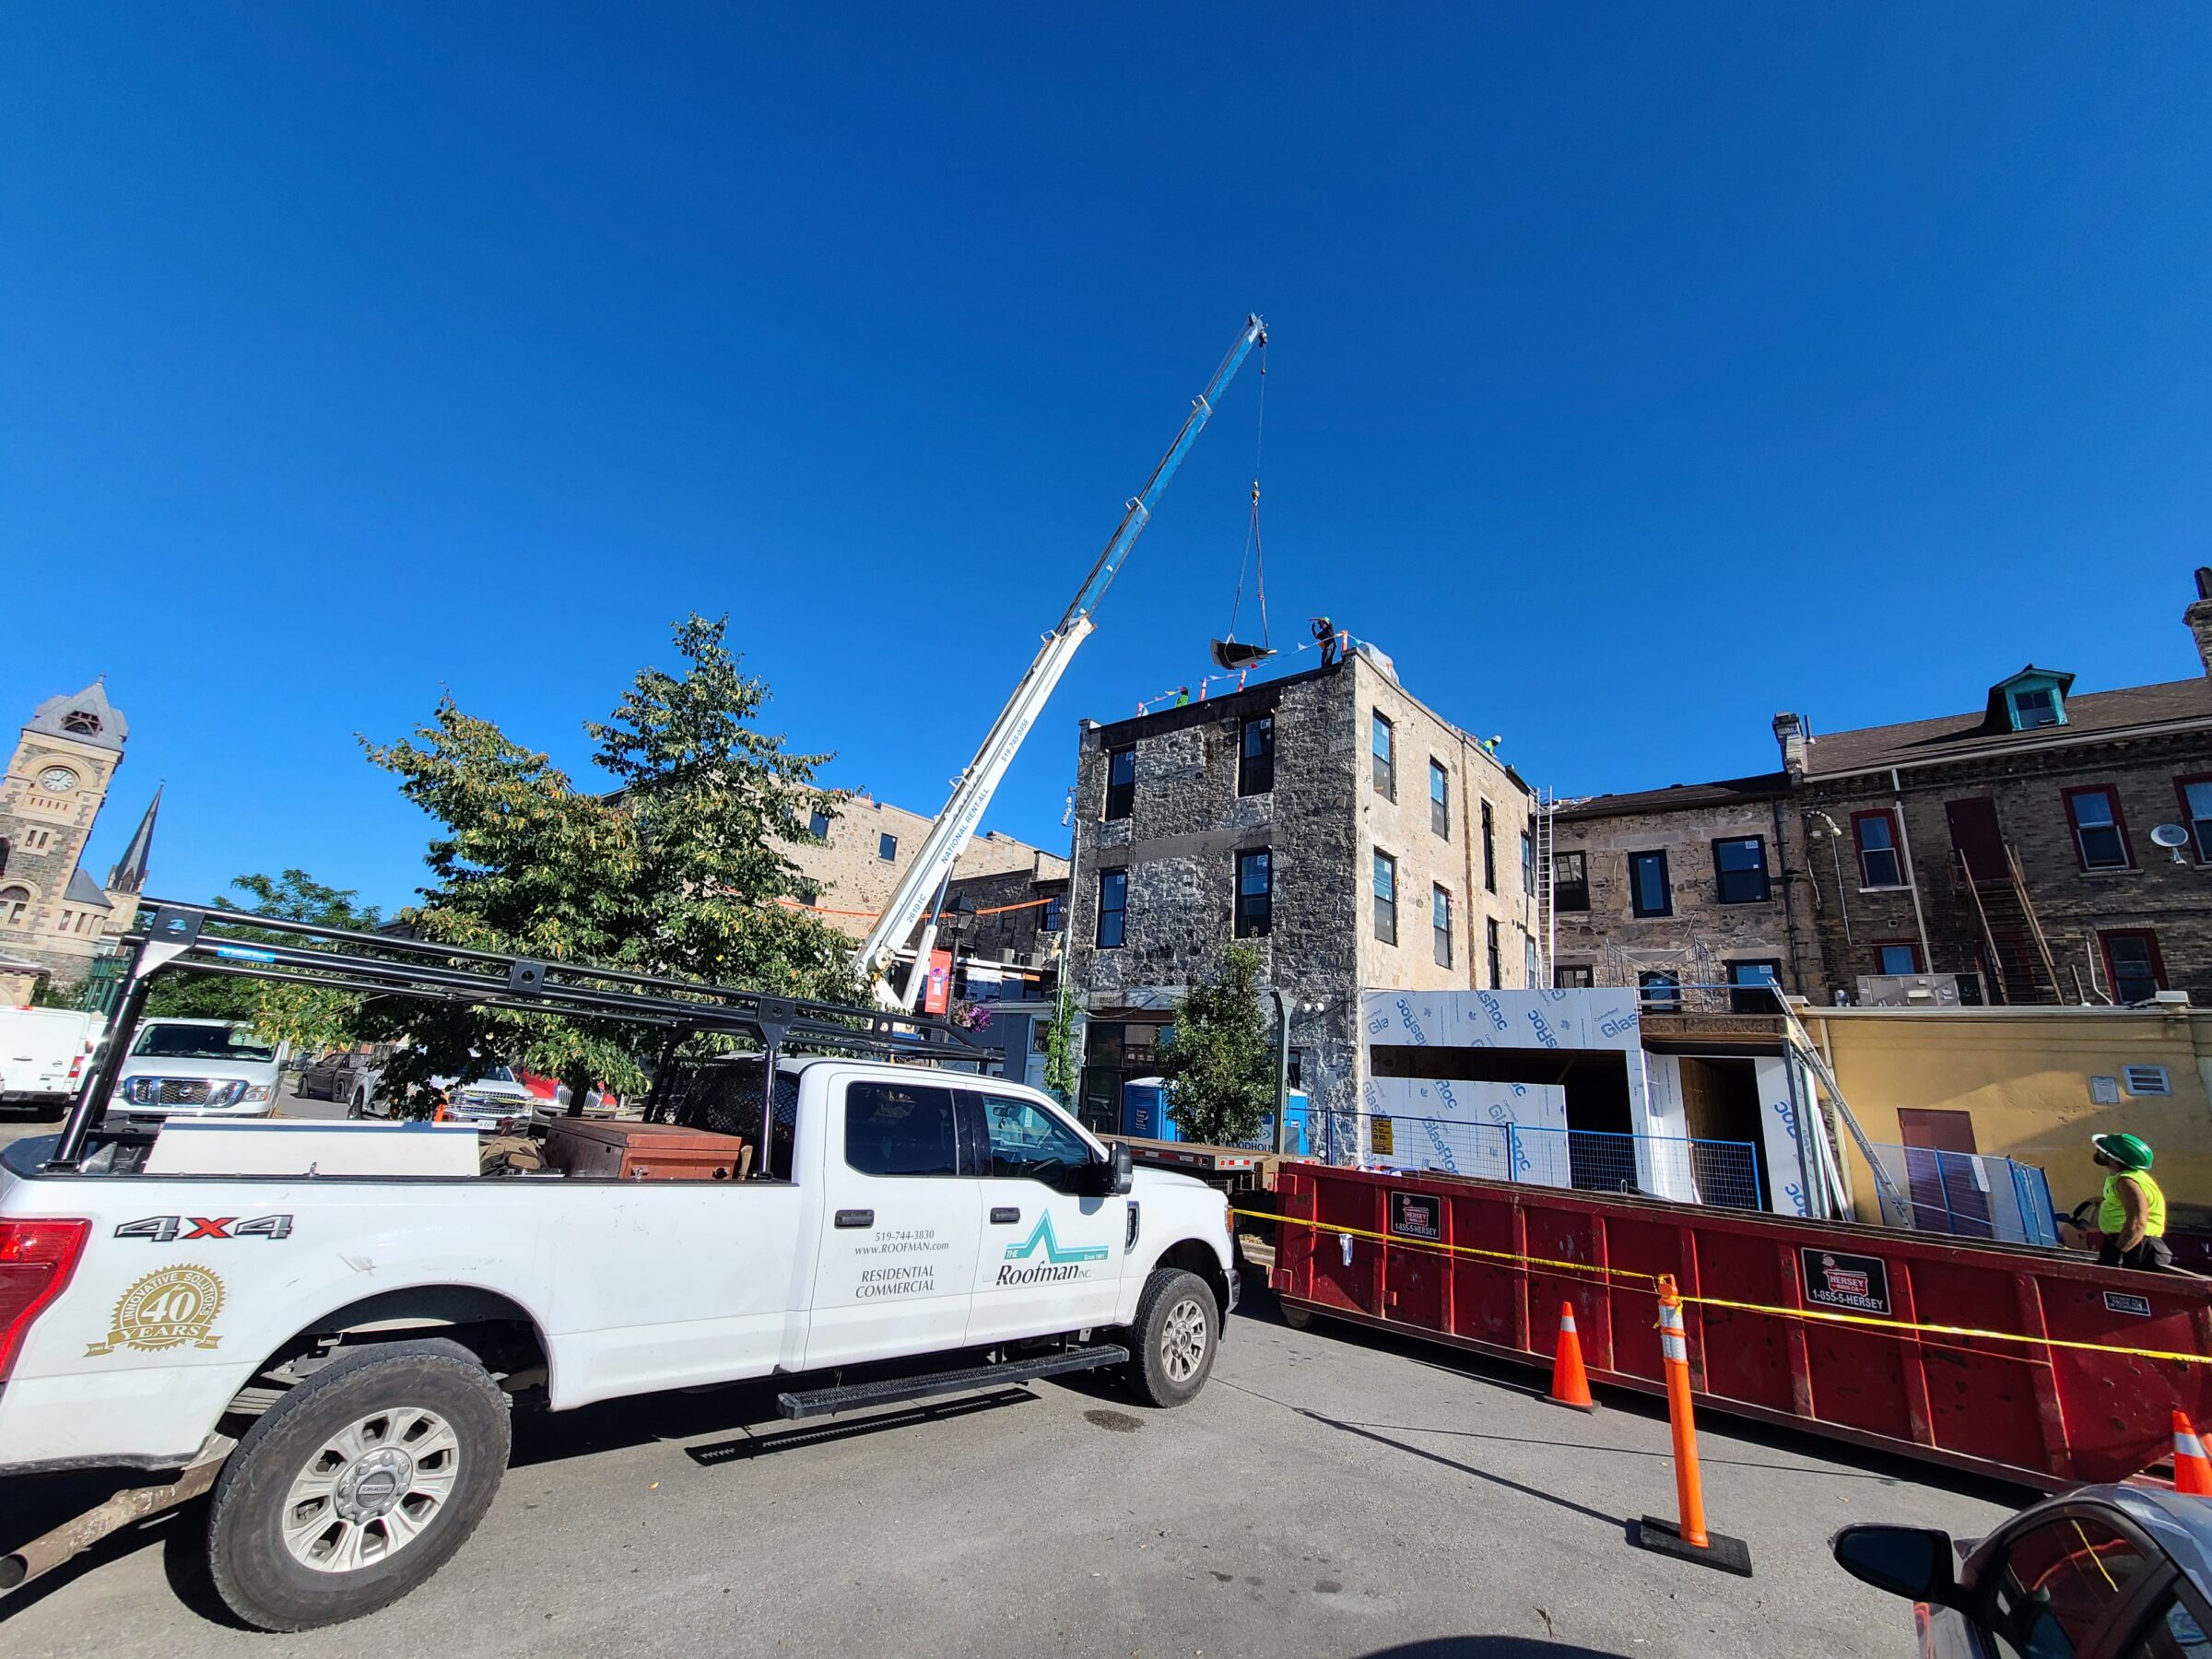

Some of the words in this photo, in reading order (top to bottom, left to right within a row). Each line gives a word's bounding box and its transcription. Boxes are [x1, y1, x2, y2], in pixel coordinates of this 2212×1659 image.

[1001, 718, 1030, 762] 519-745-0456
[941, 823, 968, 865] NATIONAL
[965, 787, 990, 824] RENT-ALL
[907, 893, 927, 924] 26101C
[1406, 1211, 1427, 1219] HERSEY
[875, 1230, 935, 1242] 519-744-3830
[1394, 1222, 1437, 1236] 1-855-5-HERSEY
[855, 1241, 949, 1255] www.ROOFMAN.com
[1006, 1250, 1018, 1258] THE
[861, 1265, 935, 1283] RESIDENTIAL
[995, 1260, 1079, 1286] Roofman
[1830, 1276, 1865, 1287] HERSEY
[123, 1273, 178, 1322] INNOVATIVE
[183, 1272, 215, 1317] SOLUTIONS
[855, 1279, 935, 1299] COMMERCIAL
[140, 1290, 196, 1324] 40
[1812, 1288, 1884, 1310] 1-855-5-HERSEY
[121, 1324, 204, 1341] YEARS
